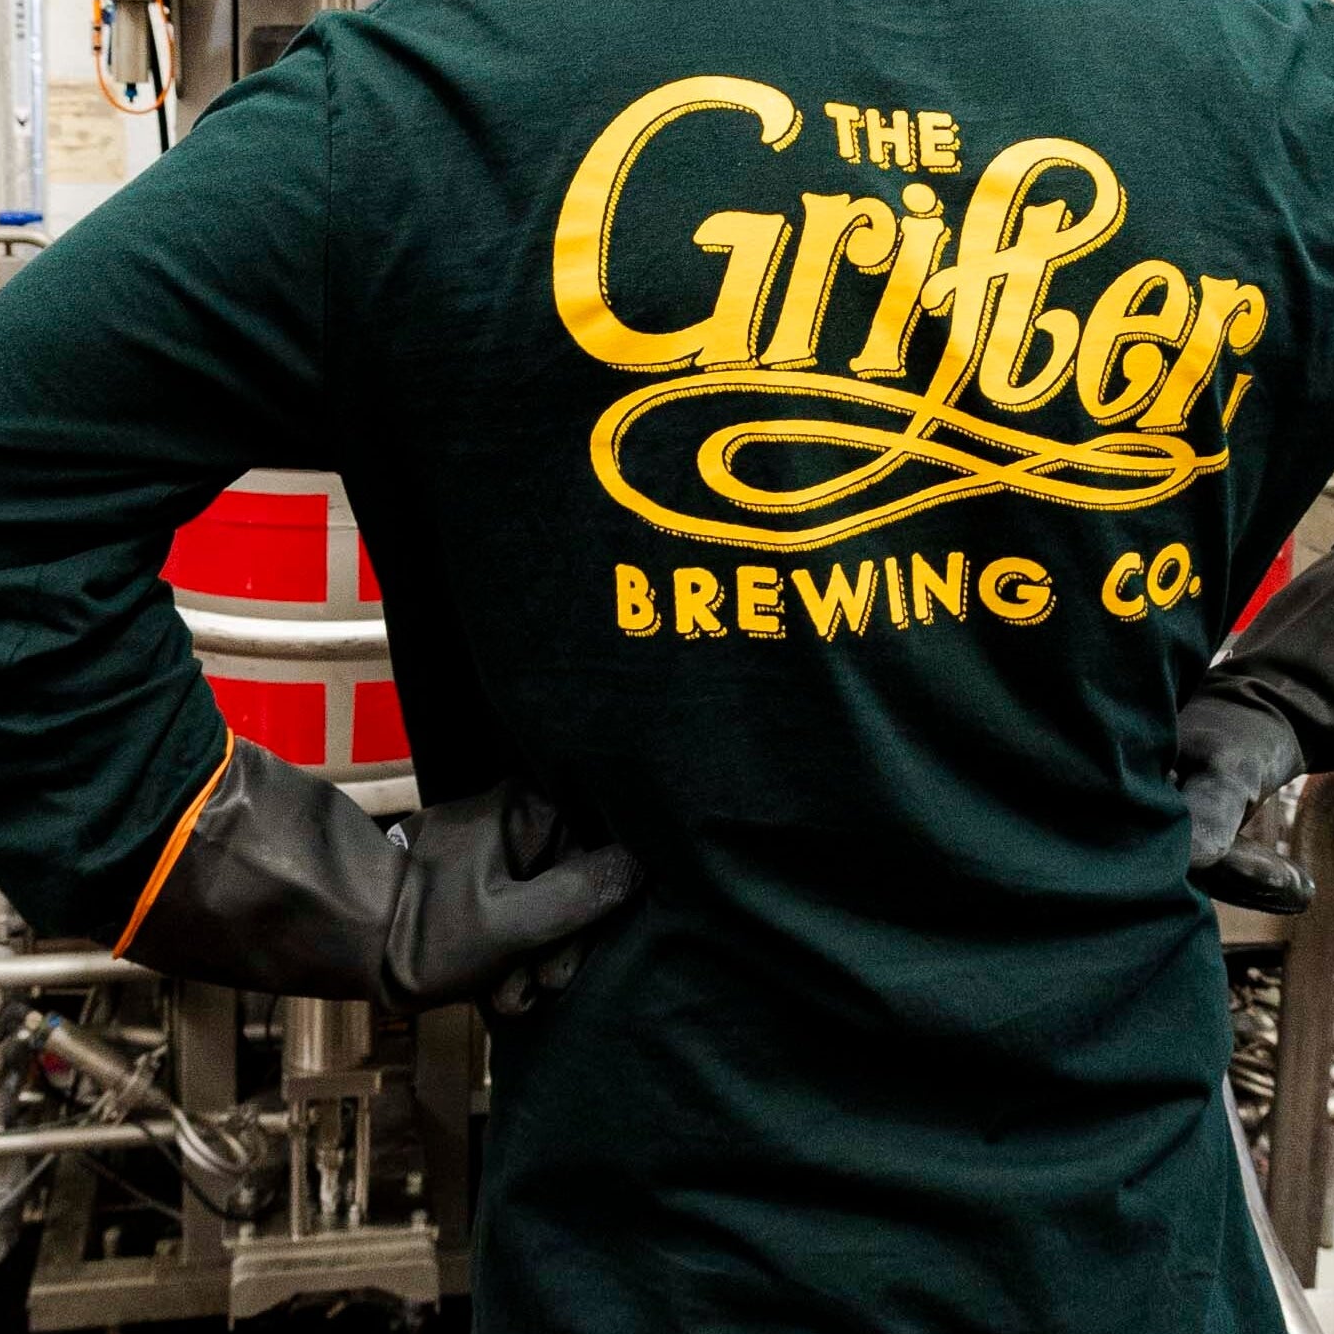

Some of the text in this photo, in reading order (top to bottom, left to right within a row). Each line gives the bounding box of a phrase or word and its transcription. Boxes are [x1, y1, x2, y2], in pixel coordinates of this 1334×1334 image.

[824, 100, 963, 175] THE
[552, 74, 1269, 551] Grifter
[614, 542, 1203, 643] BREWING CO.
